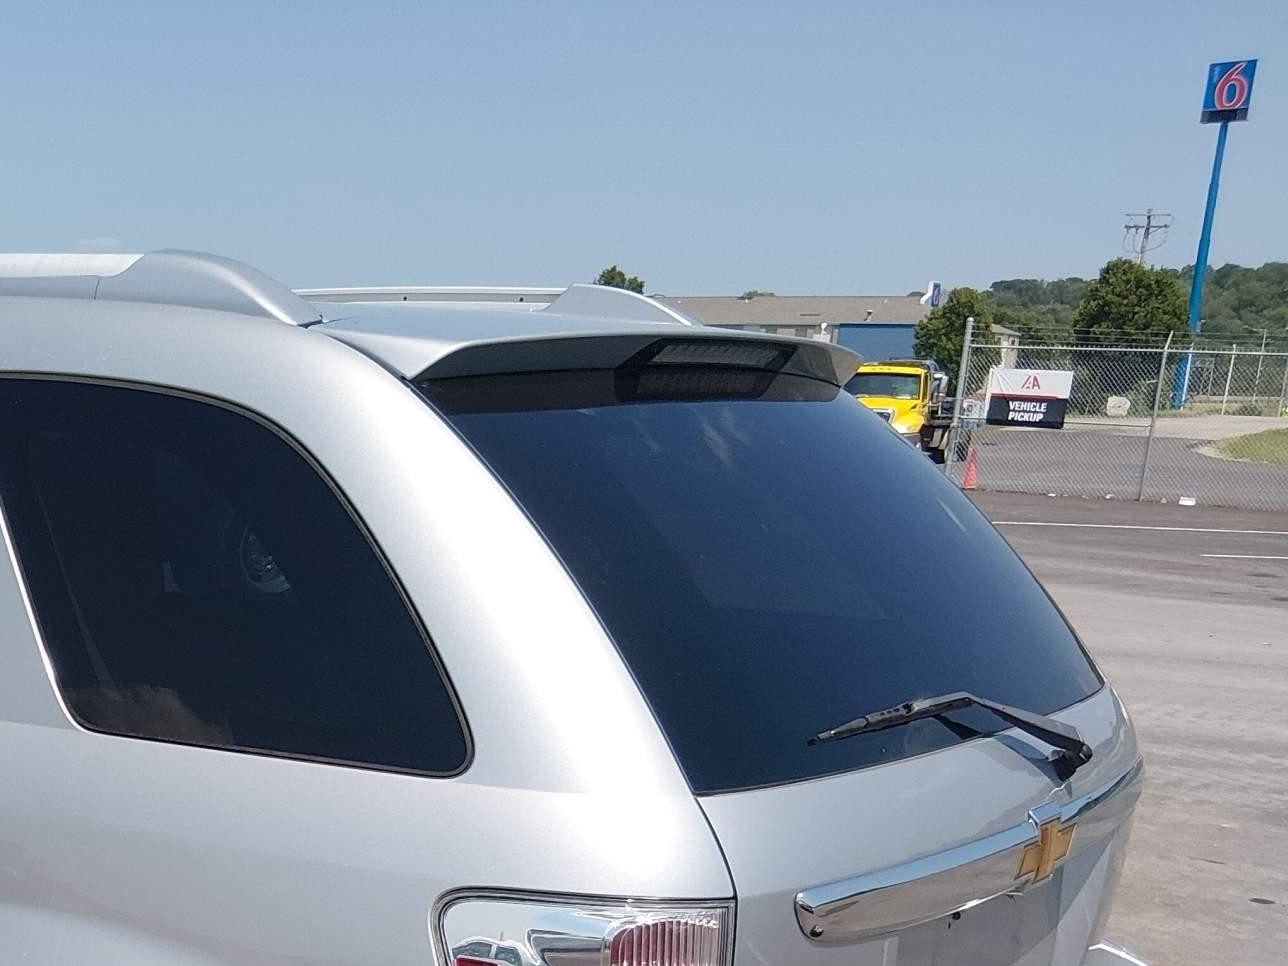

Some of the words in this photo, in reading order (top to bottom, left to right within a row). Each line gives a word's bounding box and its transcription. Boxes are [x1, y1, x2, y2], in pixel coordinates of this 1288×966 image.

[1214, 62, 1248, 110] 6
[1008, 400, 1048, 412] VEHICLE
[1007, 411, 1044, 422] PICKUP
